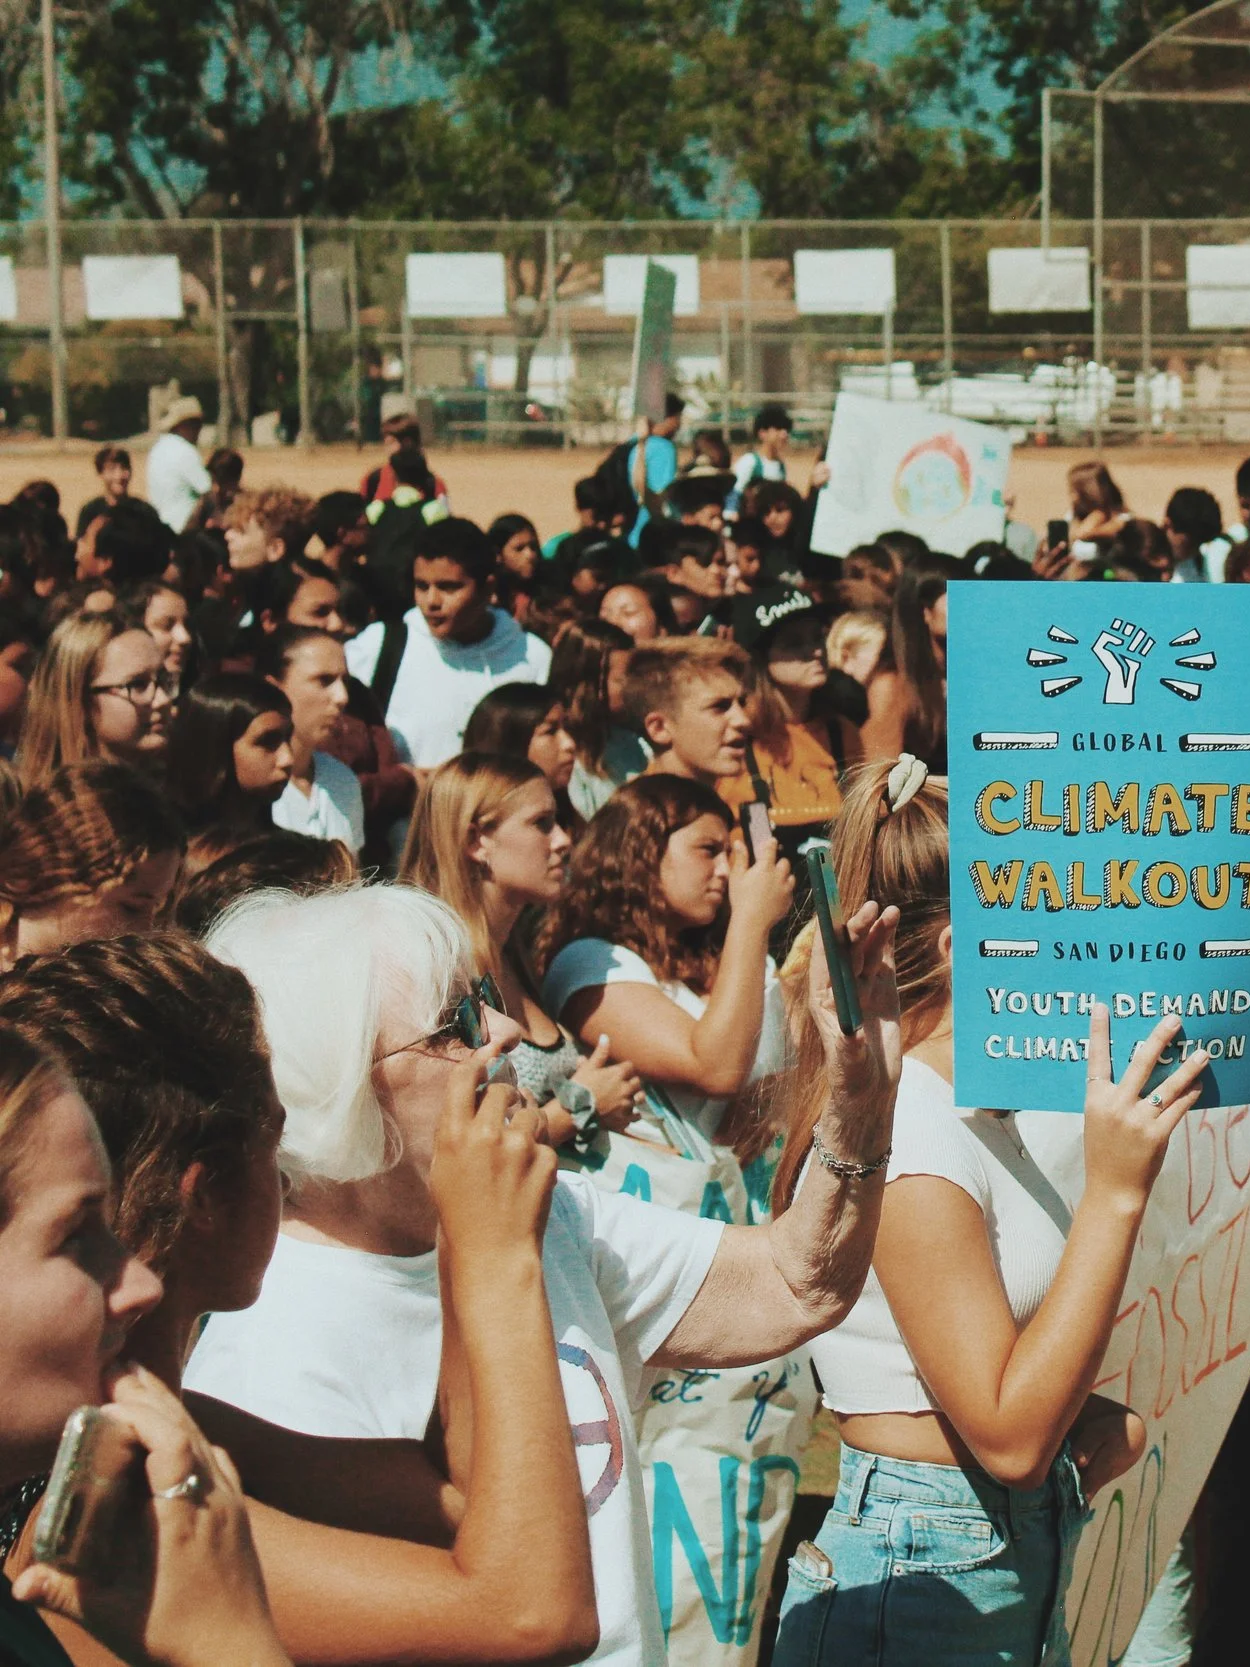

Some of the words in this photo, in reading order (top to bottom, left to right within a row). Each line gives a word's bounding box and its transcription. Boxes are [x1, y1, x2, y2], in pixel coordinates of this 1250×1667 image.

[1073, 732, 1167, 752] GLOBAL
[1053, 942, 1098, 962] SAN
[1109, 942, 1186, 962] DIEGO
[985, 987, 1097, 1017] YOUTH
[984, 1034, 1113, 1062] CLIMAT
